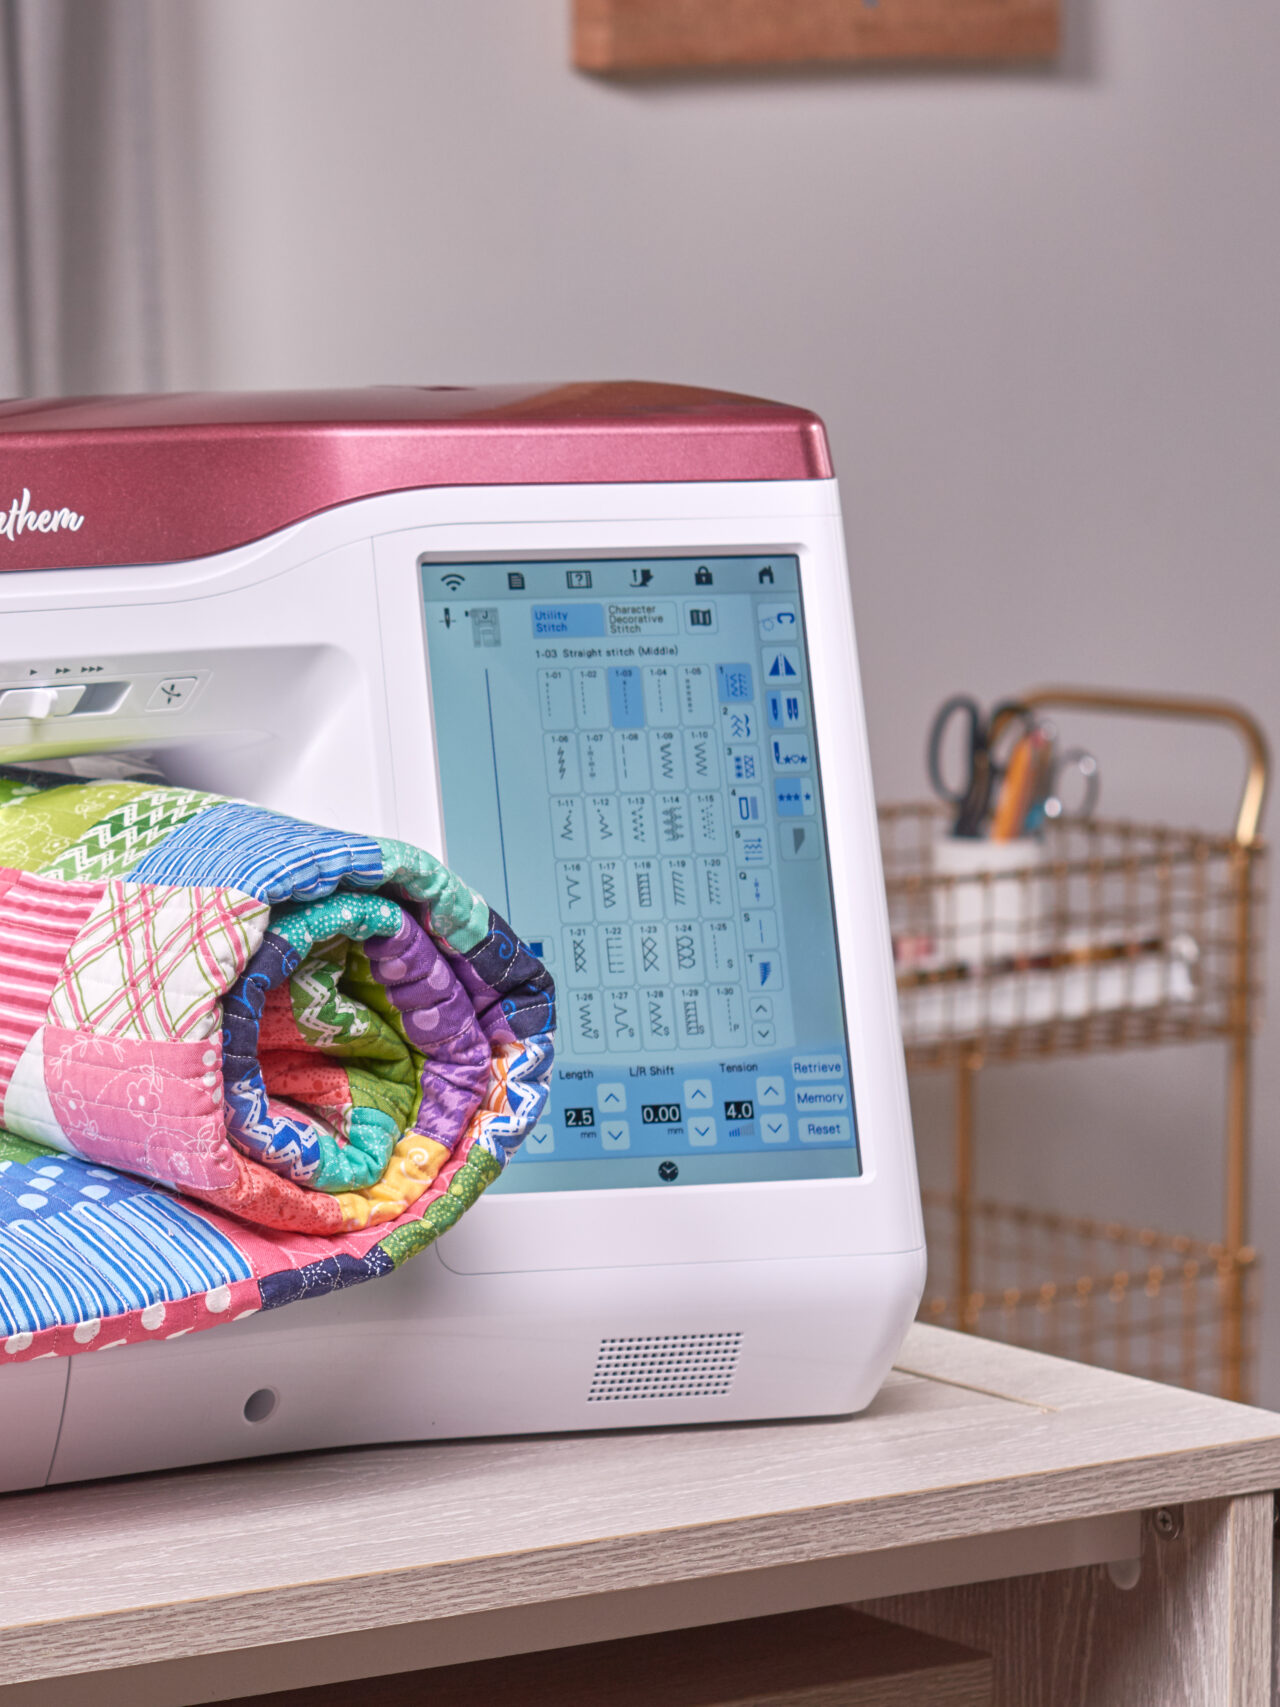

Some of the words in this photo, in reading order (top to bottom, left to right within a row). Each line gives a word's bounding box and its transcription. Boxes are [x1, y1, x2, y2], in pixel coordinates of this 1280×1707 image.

[608, 605, 656, 614] Character
[534, 610, 568, 622] Utility
[610, 614, 664, 624] Decorative
[536, 622, 568, 633] Stitch
[610, 624, 642, 634] Stitch
[536, 650, 558, 658] 1-03
[563, 648, 602, 660] Straight
[606, 646, 634, 656] stitch
[586, 734, 603, 742] 1-07
[692, 731, 708, 739] 1-10
[662, 796, 680, 804] 1-14
[599, 862, 616, 870] 1-17
[704, 859, 720, 867] 1-20
[570, 928, 586, 936] 1-21
[675, 924, 692, 932] 1-24
[612, 992, 628, 1000] 1-27
[716, 988, 734, 996] 1-30
[629, 1066, 646, 1077] L/R
[650, 1066, 674, 1076] Shift
[719, 1062, 758, 1073] Tension
[793, 1062, 841, 1074] Retrieve
[559, 1069, 594, 1080] Length
[796, 1092, 844, 1104] Memory
[643, 1106, 680, 1122] 0.00
[726, 1102, 752, 1118] 4.0
[566, 1110, 592, 1126] 2.5
[808, 1123, 840, 1135] Reset
